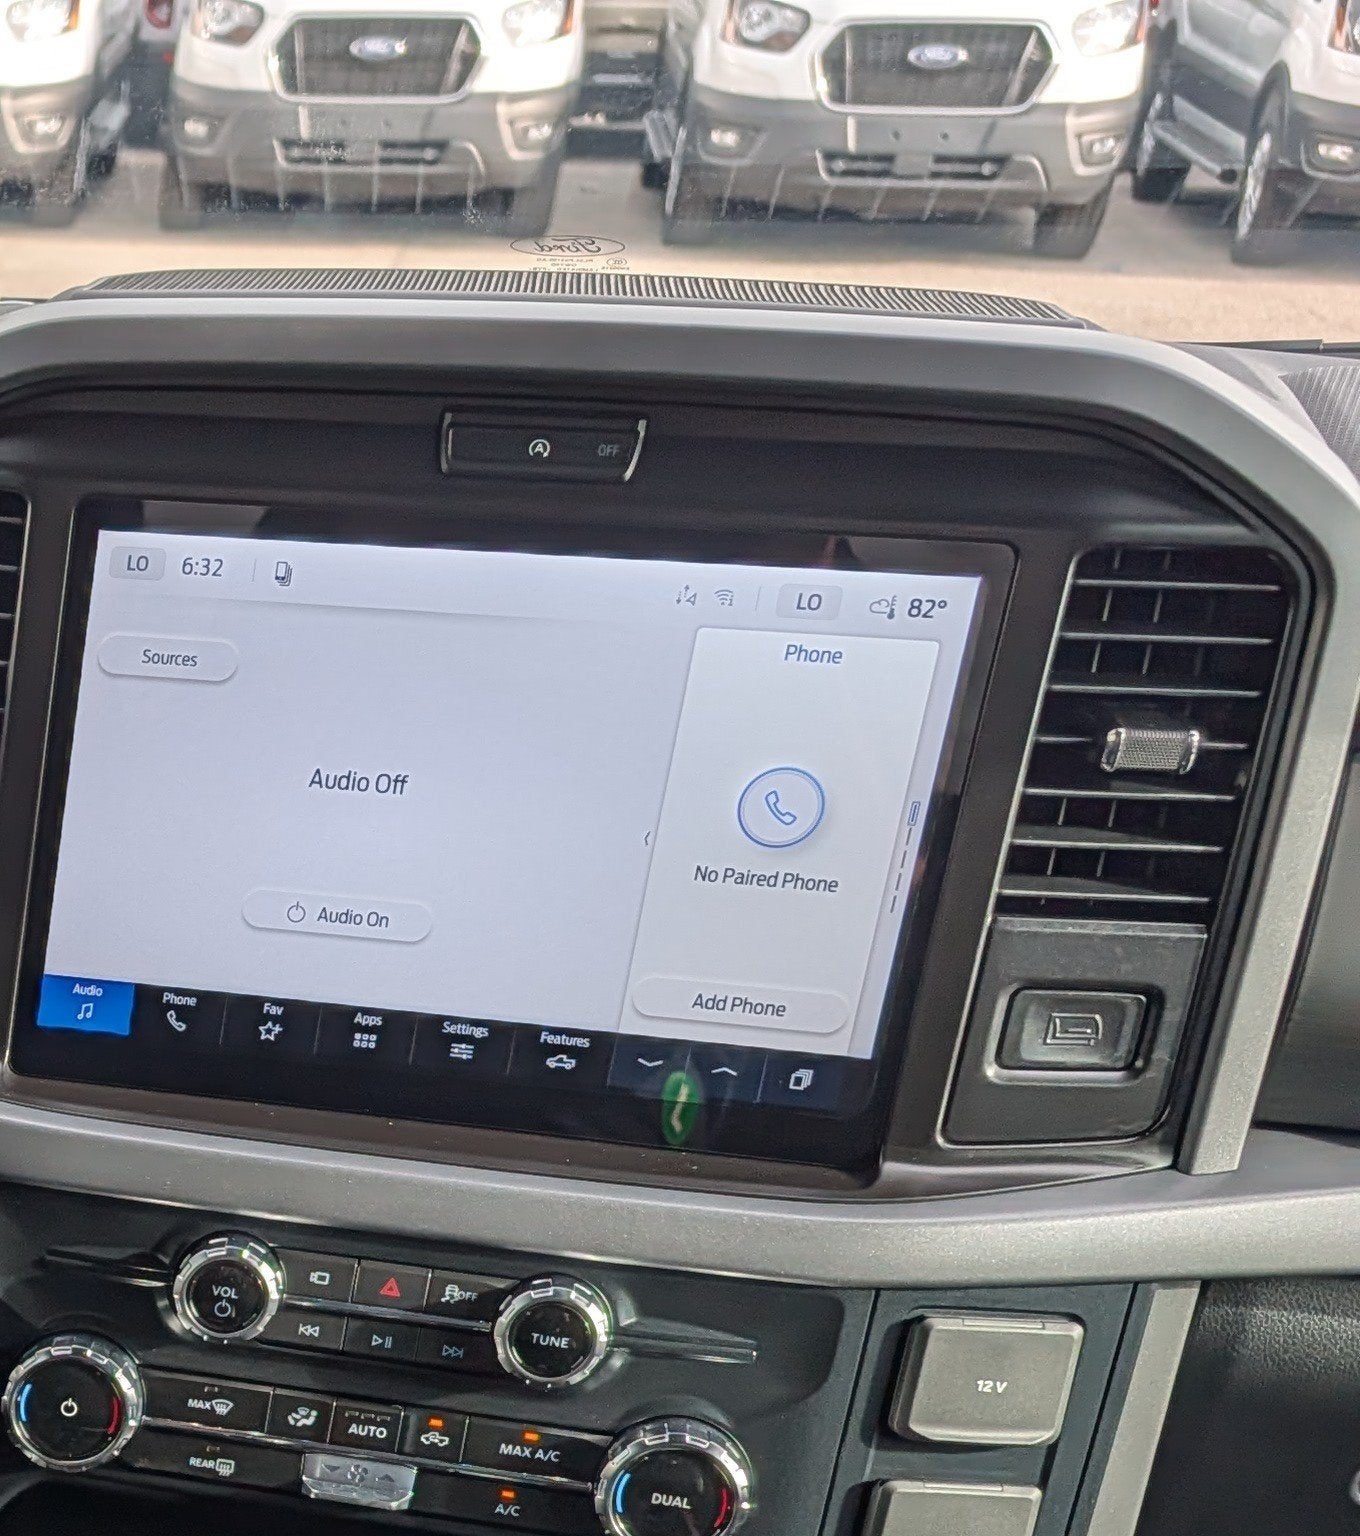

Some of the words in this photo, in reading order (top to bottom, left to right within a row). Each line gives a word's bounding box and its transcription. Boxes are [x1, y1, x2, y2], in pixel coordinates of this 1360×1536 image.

[598, 444, 619, 457] OFF
[126, 554, 149, 572] LO
[181, 556, 224, 577] 6:32
[796, 592, 822, 611] LO
[907, 598, 947, 619] 82°
[141, 648, 198, 667] Sources
[784, 644, 843, 664] Phone
[308, 768, 370, 792] Audio
[375, 773, 410, 795] Off
[693, 865, 719, 883] No
[722, 867, 779, 888] Paired
[781, 872, 839, 893] Phone
[317, 906, 363, 926] Audio
[366, 911, 390, 928] On
[72, 983, 103, 997] Audio
[162, 992, 197, 1007] Phone
[692, 993, 728, 1011] Add
[730, 996, 786, 1017] Phone
[263, 1002, 284, 1016] Fav
[353, 1012, 383, 1027] Apps
[441, 1021, 489, 1039] Settings
[539, 1031, 591, 1048] Features
[212, 1284, 239, 1299] VOL
[458, 1290, 479, 1302] OFF
[531, 1332, 570, 1349] TUNE
[977, 1379, 993, 1393] 12
[996, 1381, 1008, 1394] V
[187, 1398, 211, 1411] MAX
[348, 1423, 387, 1439] AUTO
[499, 1443, 531, 1458] MAX
[534, 1449, 561, 1463] A/C
[189, 1457, 216, 1470] REAR
[651, 1492, 692, 1510] DUAL
[494, 1503, 521, 1517] A/C
